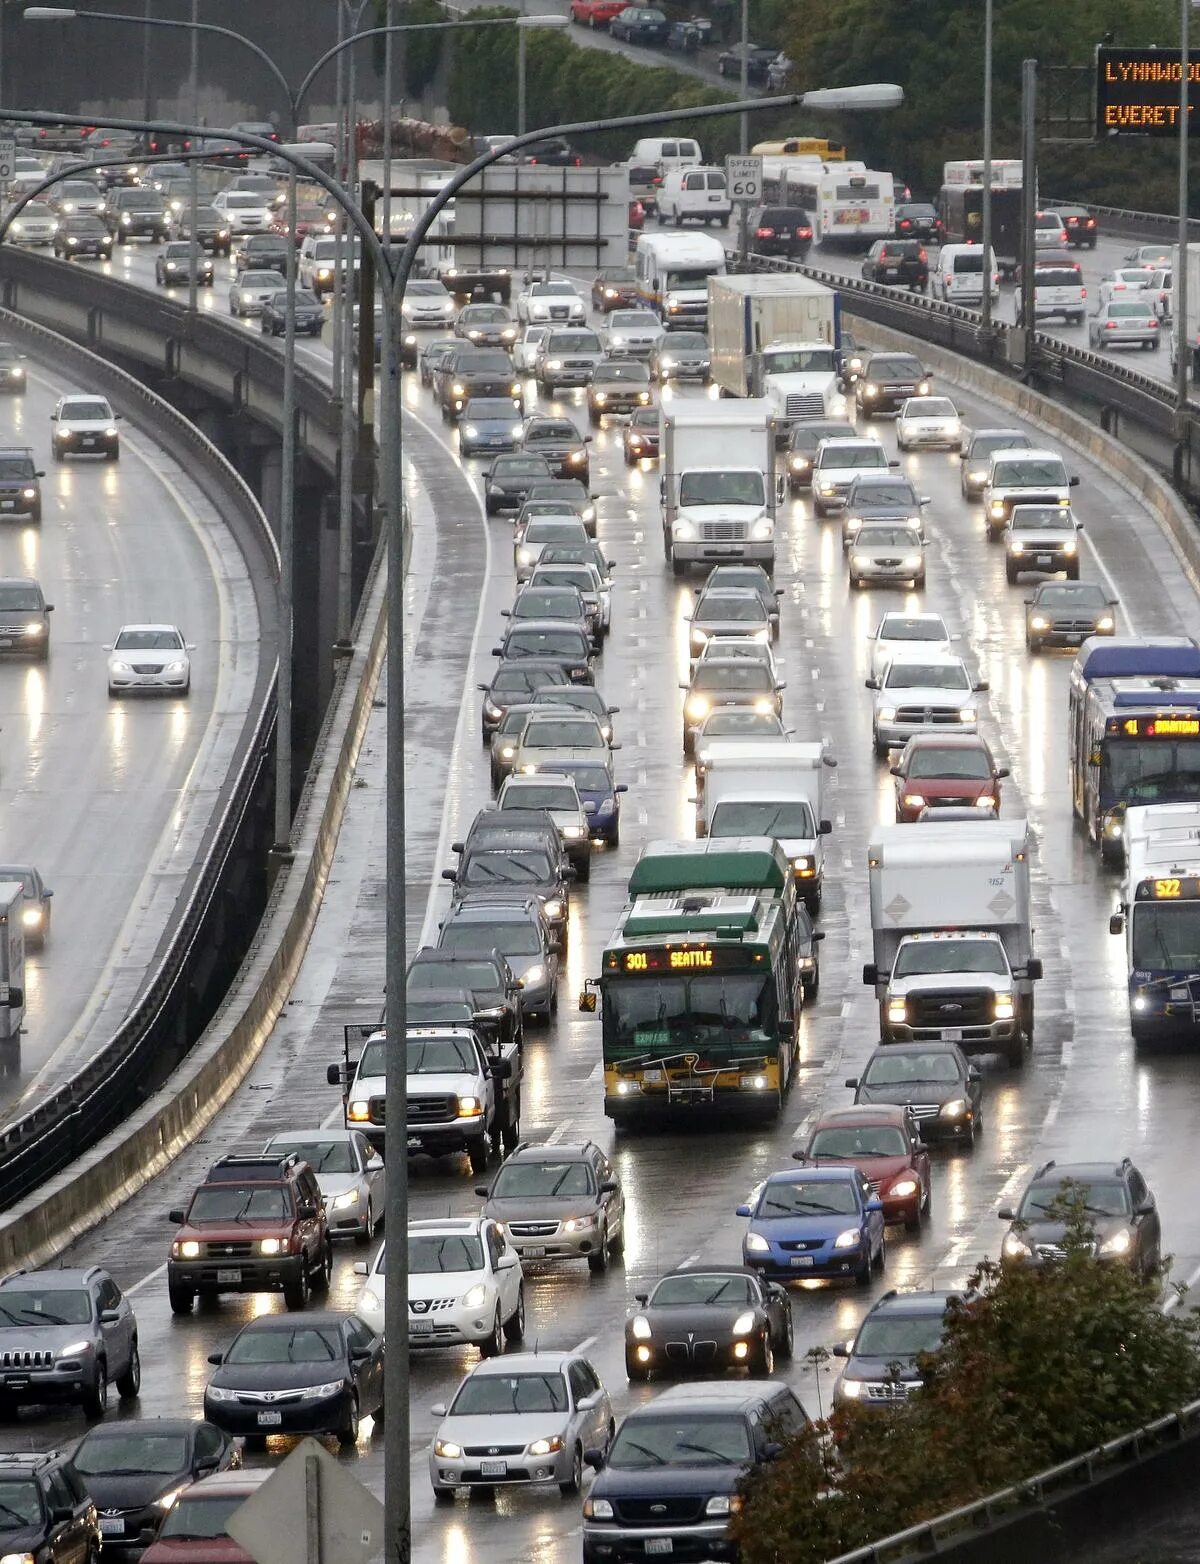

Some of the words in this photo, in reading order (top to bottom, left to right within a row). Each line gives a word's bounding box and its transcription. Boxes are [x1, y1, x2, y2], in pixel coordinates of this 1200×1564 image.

[1105, 105, 1194, 125] EVERET
[733, 169, 756, 177] LIMIT
[733, 182, 756, 195] 60
[1124, 719, 1138, 735] 41
[1154, 879, 1181, 897] 522
[626, 952, 648, 970] 301
[670, 950, 713, 968] SEATTLE
